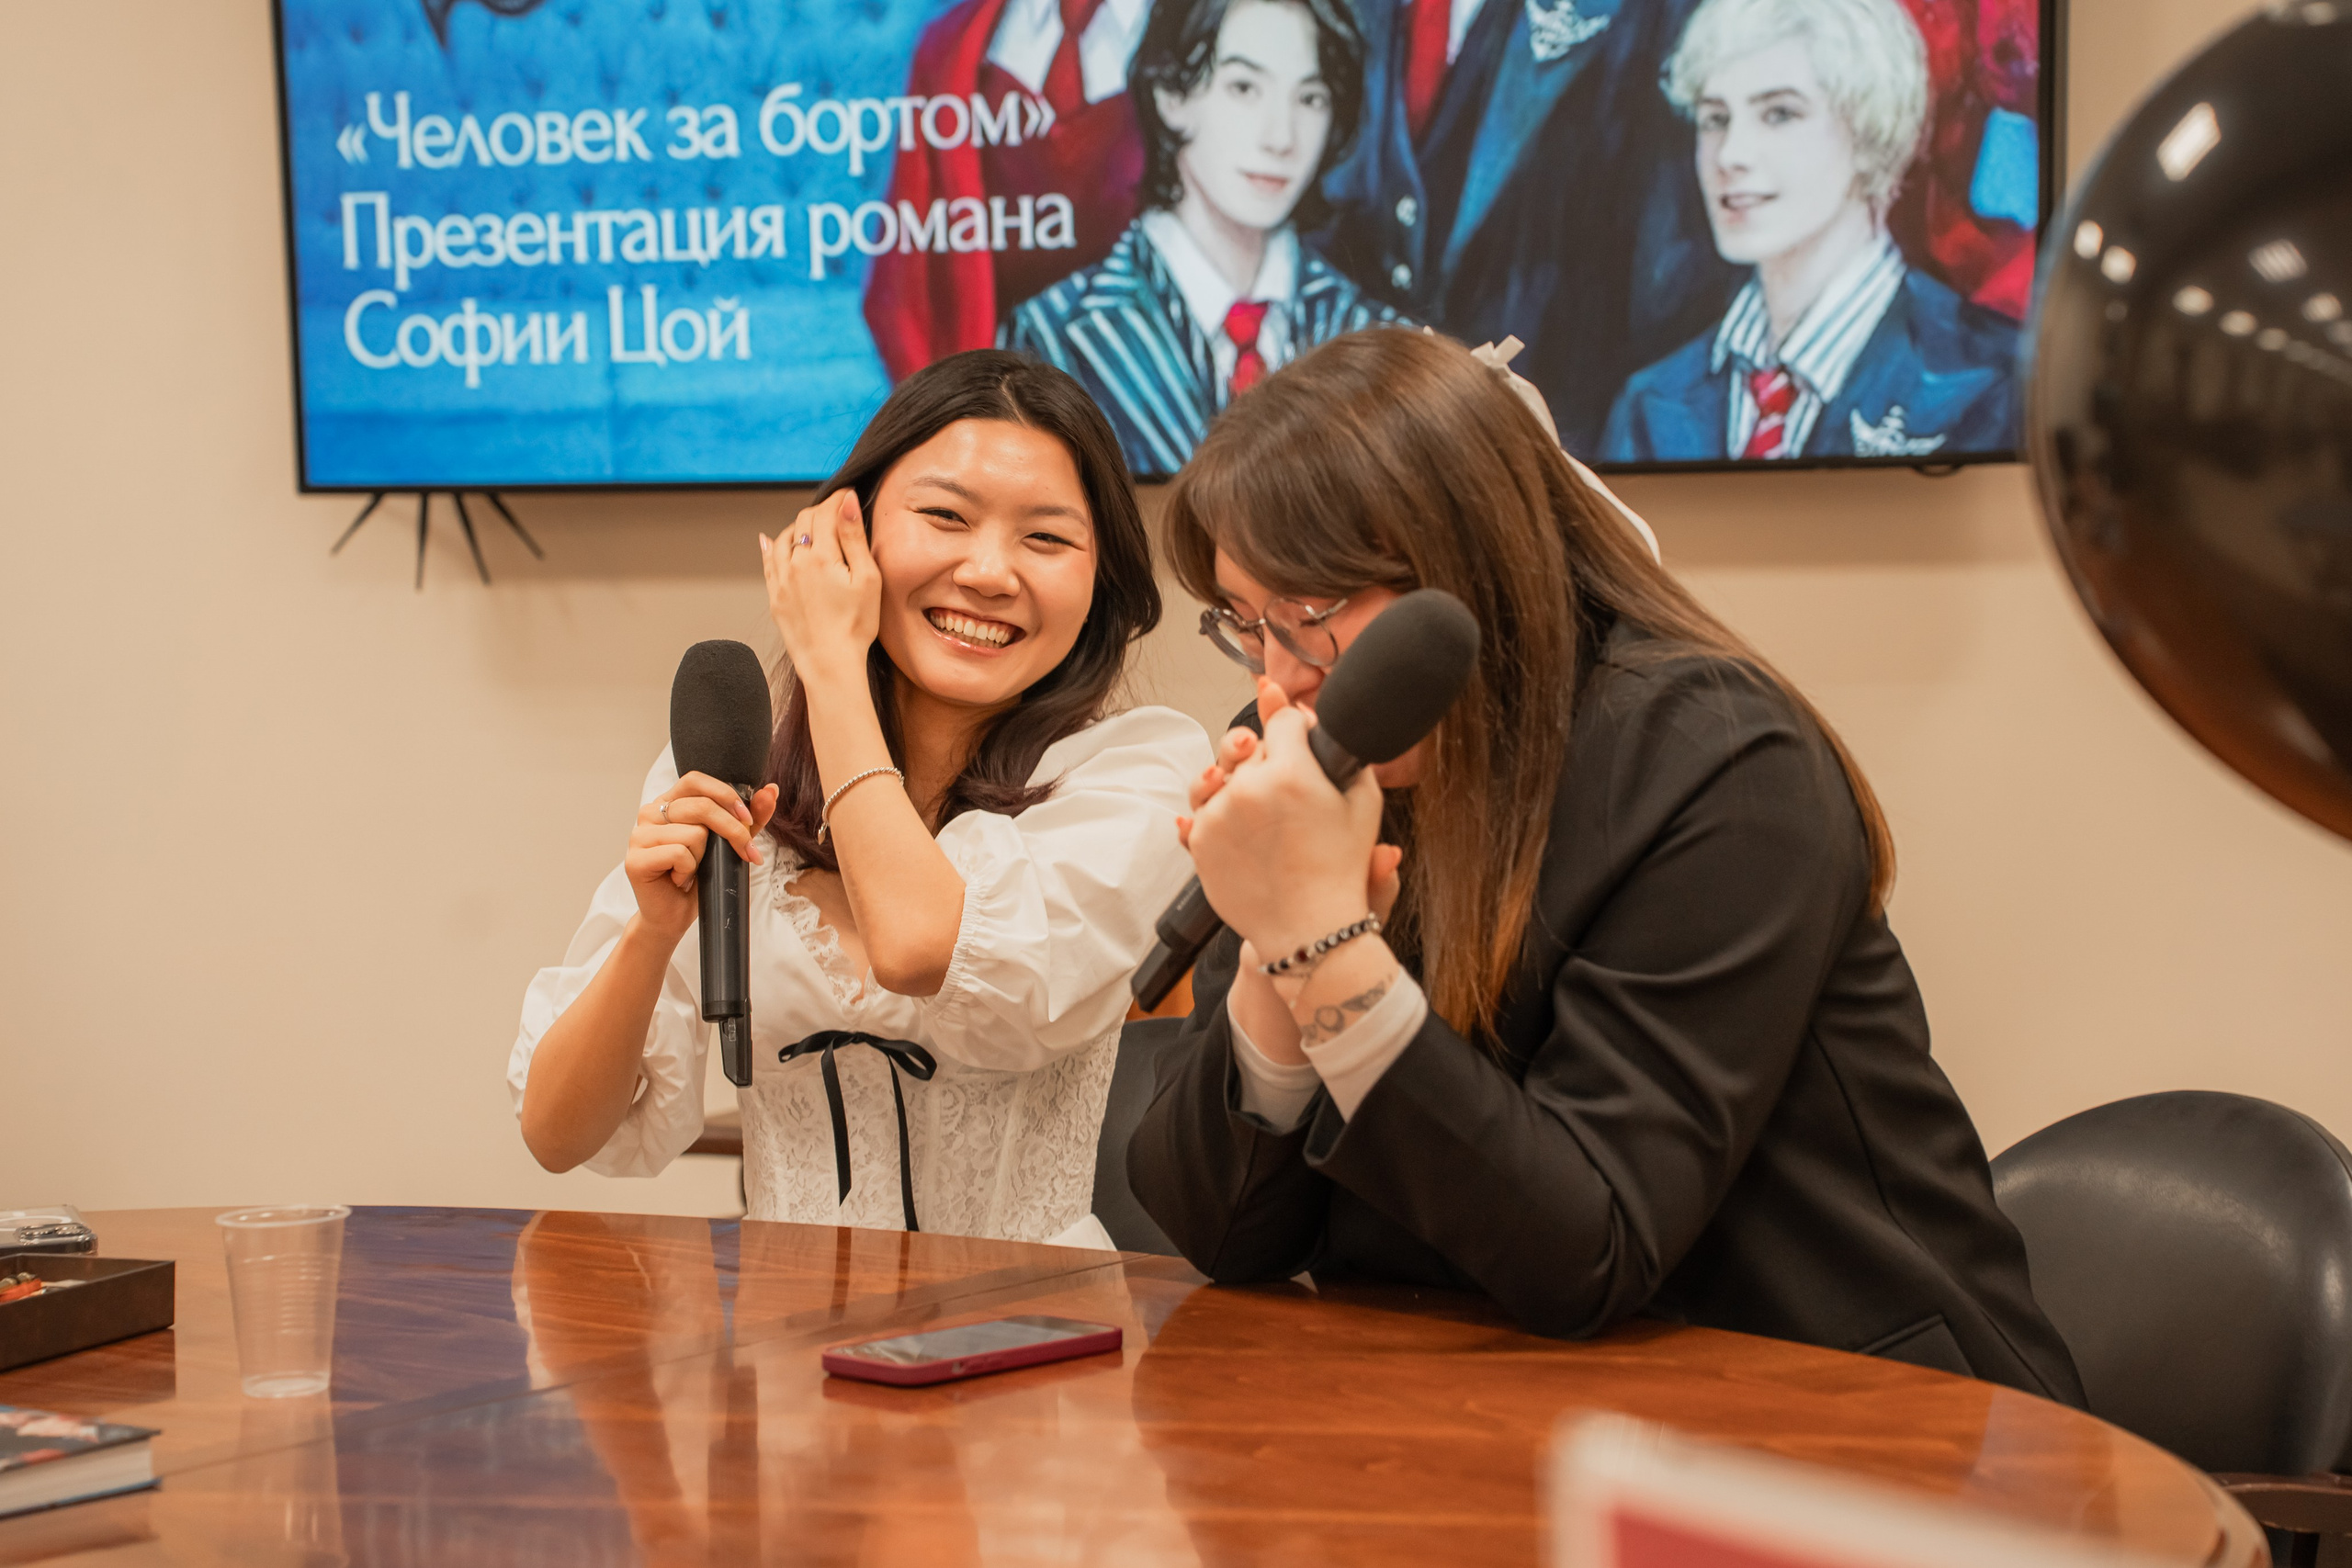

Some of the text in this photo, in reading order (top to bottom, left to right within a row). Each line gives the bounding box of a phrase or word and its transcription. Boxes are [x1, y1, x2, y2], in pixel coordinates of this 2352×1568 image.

[335, 84, 1057, 176] «Человек за бортом»
[340, 191, 1077, 291] Презентация романа
[343, 285, 752, 389] Софии Цой
